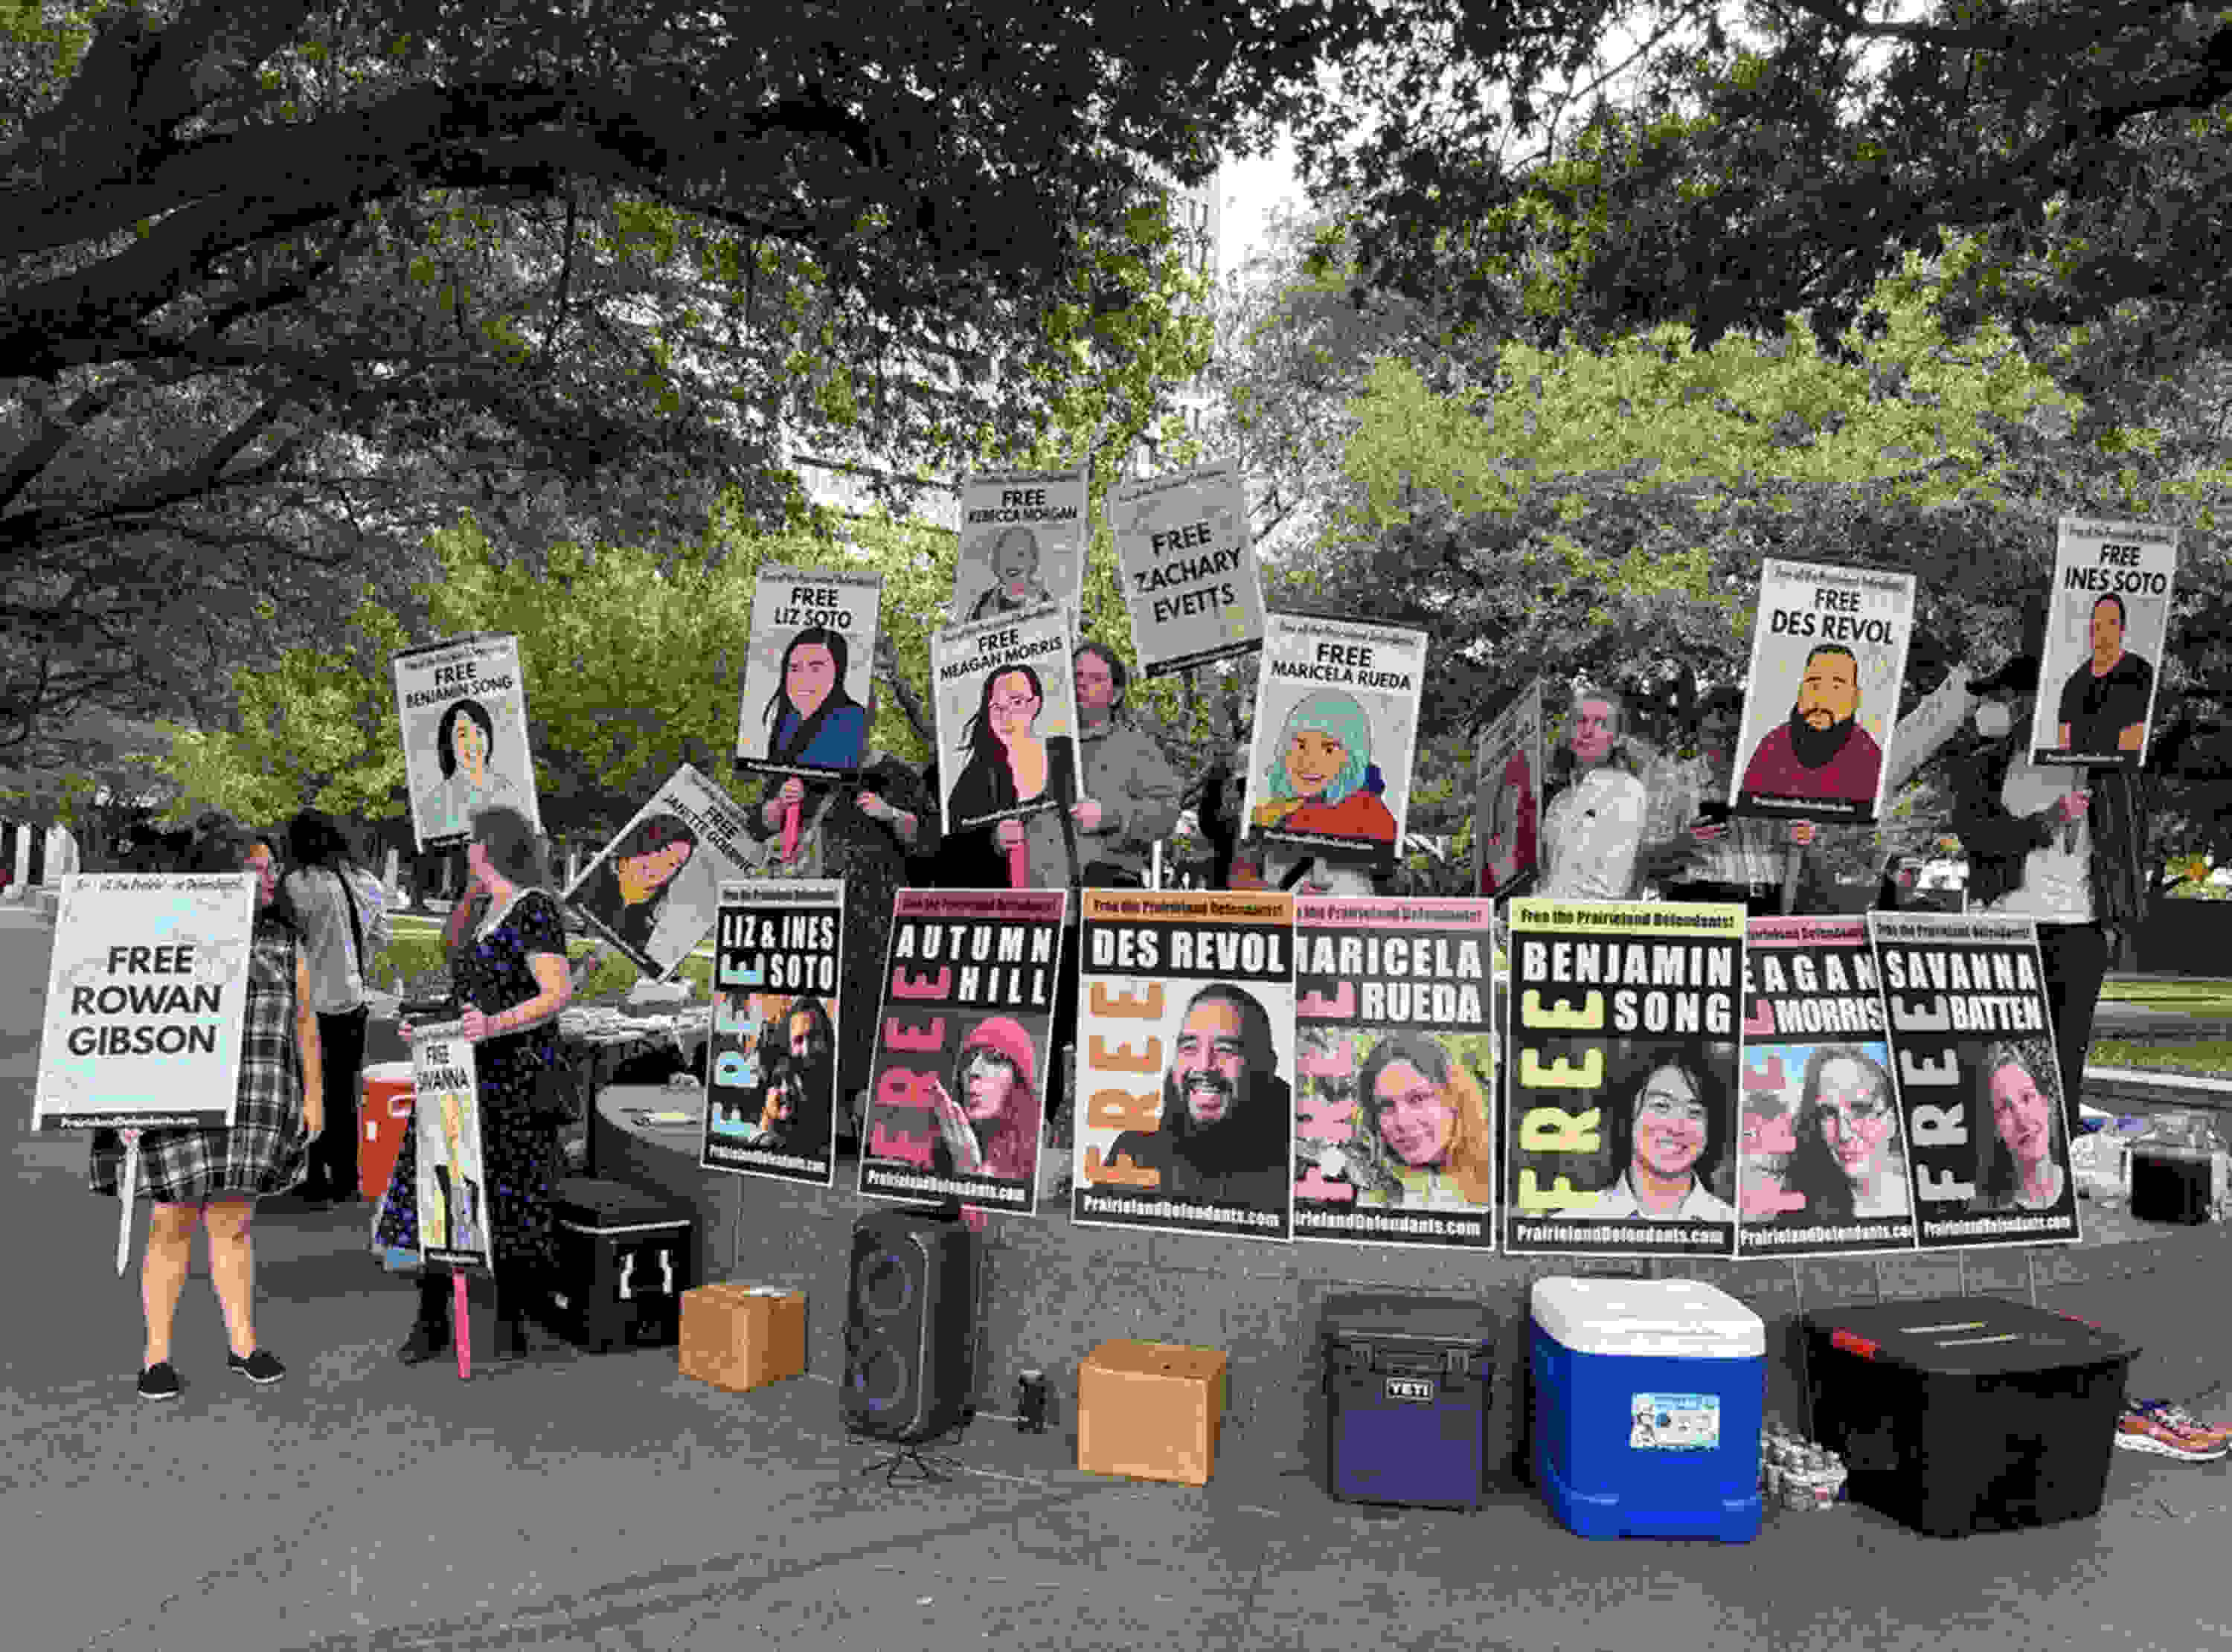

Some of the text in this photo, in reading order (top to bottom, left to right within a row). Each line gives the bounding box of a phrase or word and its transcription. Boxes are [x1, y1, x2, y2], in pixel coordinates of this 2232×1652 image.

[1003, 489, 1045, 506] FREE
[1152, 521, 1211, 558] FREE
[2101, 544, 2140, 566] FREE
[1134, 547, 1241, 593] ZACHARY
[2065, 567, 2167, 594] INES SOTO
[791, 587, 838, 607] FREE
[1154, 584, 1234, 623] EVETTS
[1815, 588, 1861, 613] FREE
[775, 606, 851, 629] LIZ SOTO
[1771, 608, 1893, 645] DES REVOL
[940, 636, 1062, 680] MEAGAN MORRIS
[978, 629, 1019, 652] FREE
[1317, 643, 1372, 668] FREE
[434, 663, 477, 685] FREE
[1271, 660, 1411, 691] MARICELA RUEDA
[708, 806, 739, 840] FREE
[722, 915, 834, 950] LIZ & INES
[896, 925, 1053, 963] AUTUMN
[108, 945, 196, 975] FREE
[1091, 928, 1285, 974] DES REVOL
[1522, 940, 1732, 986] BENJAMIN
[769, 954, 834, 991] SOTO
[958, 966, 1047, 1005] HILL
[1744, 953, 1877, 994] EAGAN
[1885, 950, 2037, 991] SAVANNA
[71, 985, 222, 1016] ROWAN
[1362, 982, 1483, 1023] RUEDA
[1613, 990, 1732, 1034] SONG
[1774, 997, 1884, 1035] MORRIS
[1949, 995, 2043, 1030] BATTEN
[68, 1025, 217, 1056] GIBSON
[712, 954, 765, 1143] FREE
[870, 965, 952, 1172] FREE
[1083, 981, 1163, 1189] FREE
[1519, 989, 1605, 1214] FREE
[1891, 994, 1975, 1201] FREE
[1083, 1195, 1280, 1227] PrairielandDefendants.com
[1295, 1210, 1481, 1237] irielandDefendants.com
[1516, 1224, 1725, 1245] PrairielandDefendants.com
[1391, 1383, 1428, 1396] YETI
